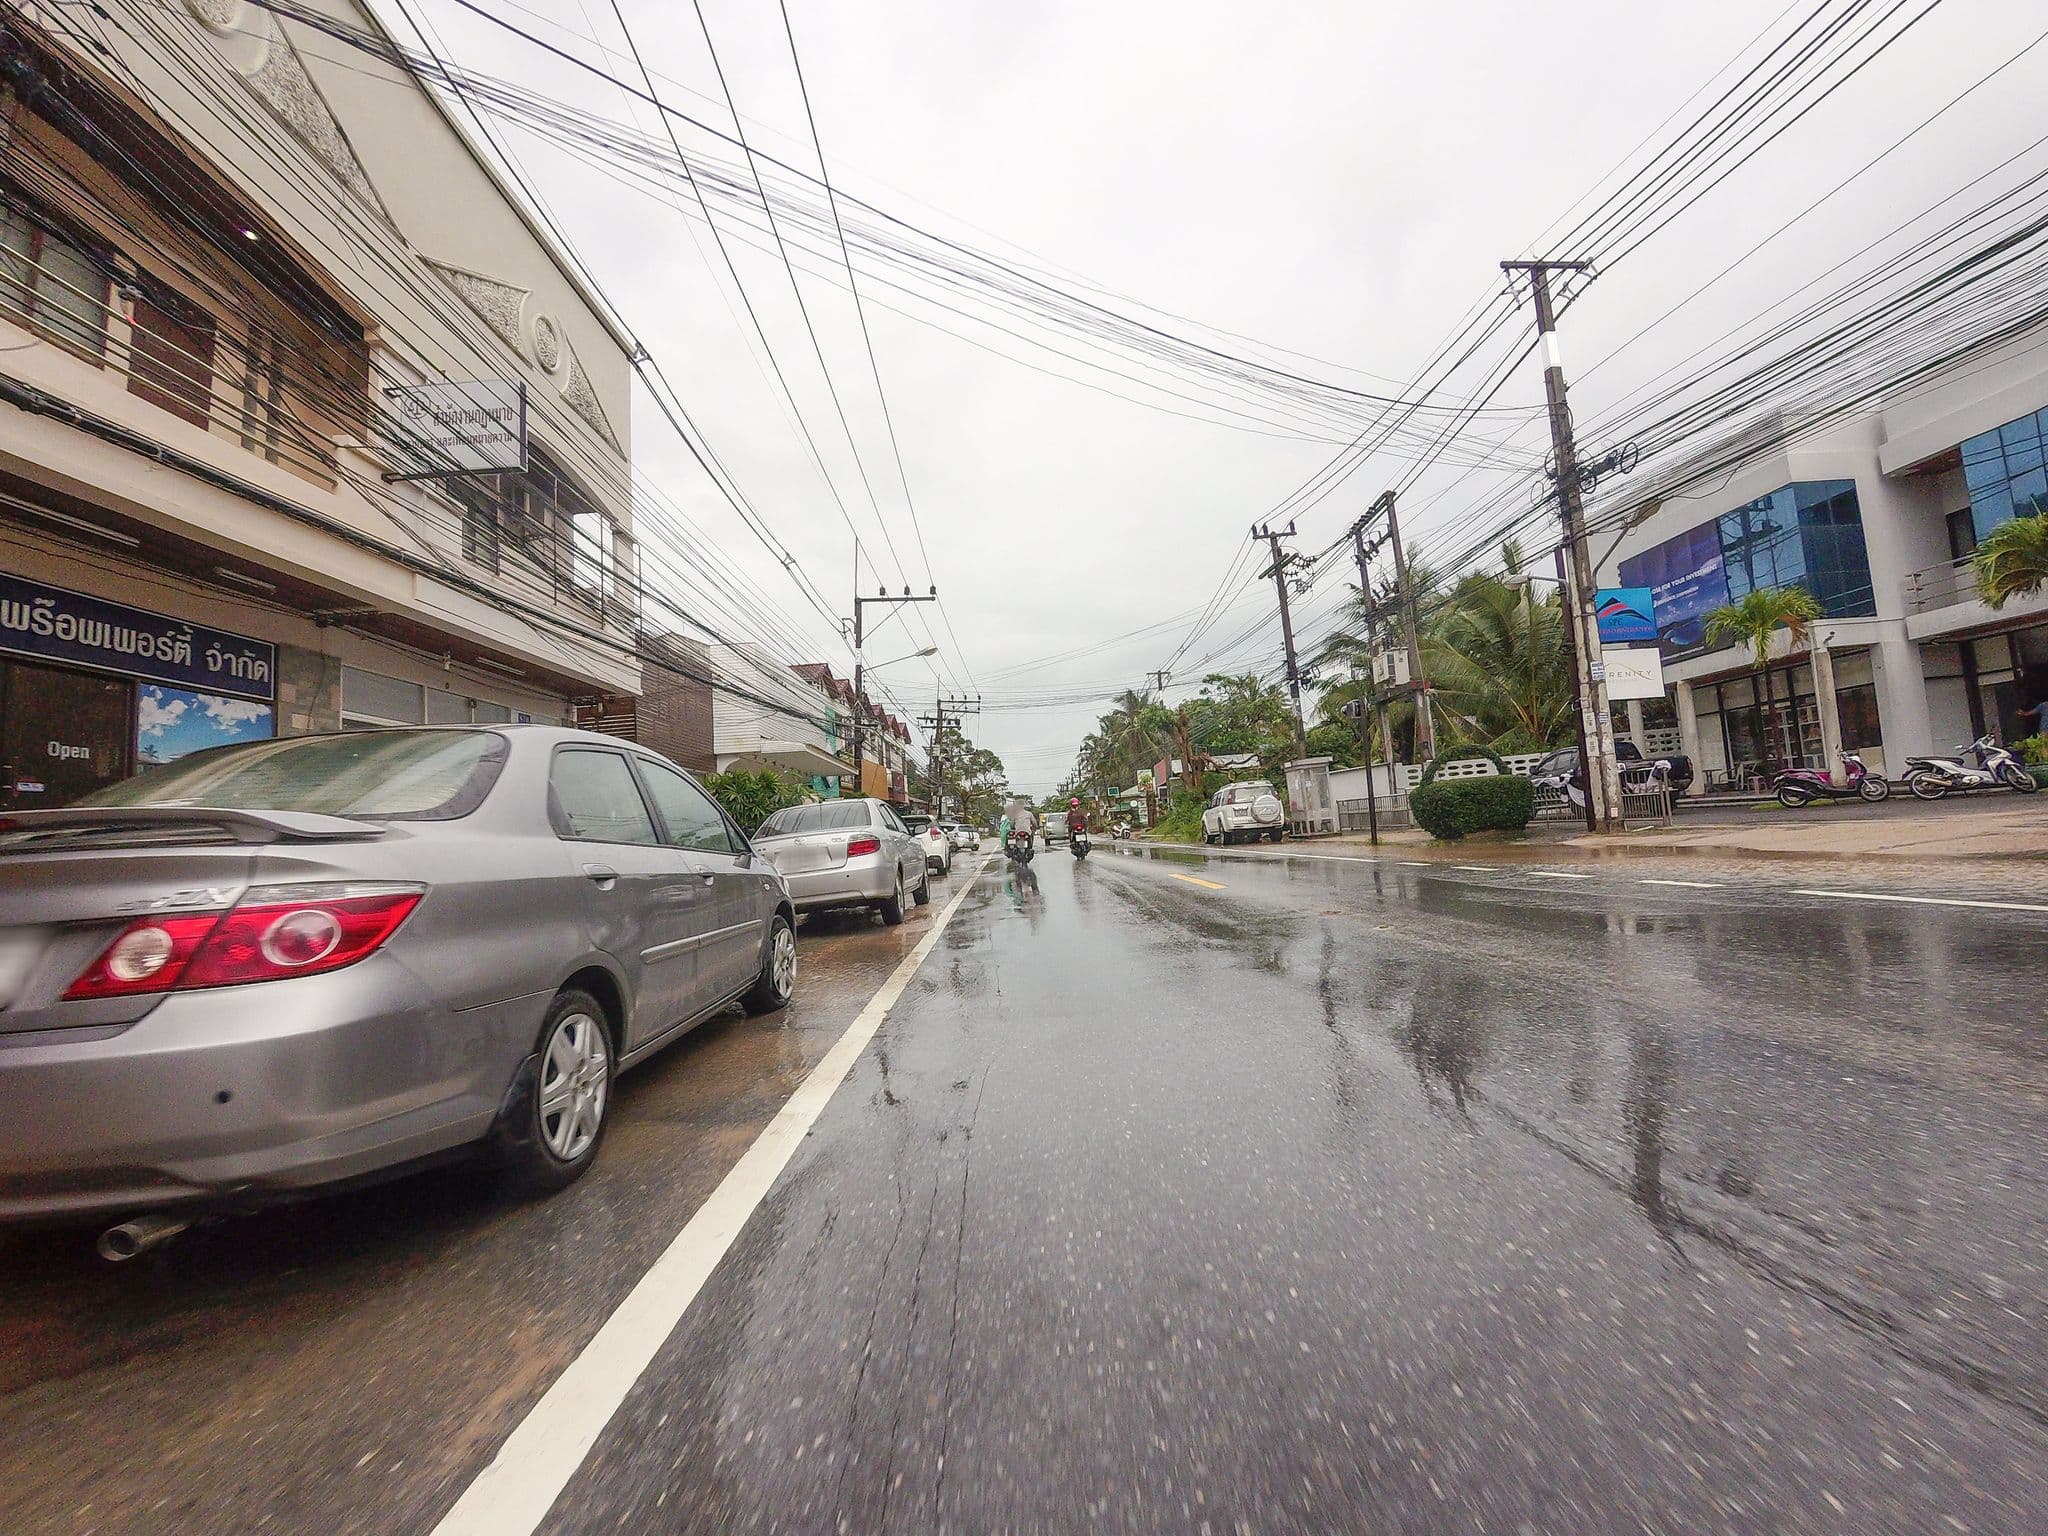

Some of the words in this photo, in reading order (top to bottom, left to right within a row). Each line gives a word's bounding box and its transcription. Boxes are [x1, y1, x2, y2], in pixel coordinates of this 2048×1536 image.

[1671, 577, 1685, 587] YOUR
[1686, 564, 1717, 580] INVESTMENT
[206, 643, 269, 682] จำกัด
[1608, 670, 1652, 679] RENITY
[47, 741, 90, 760] Open
